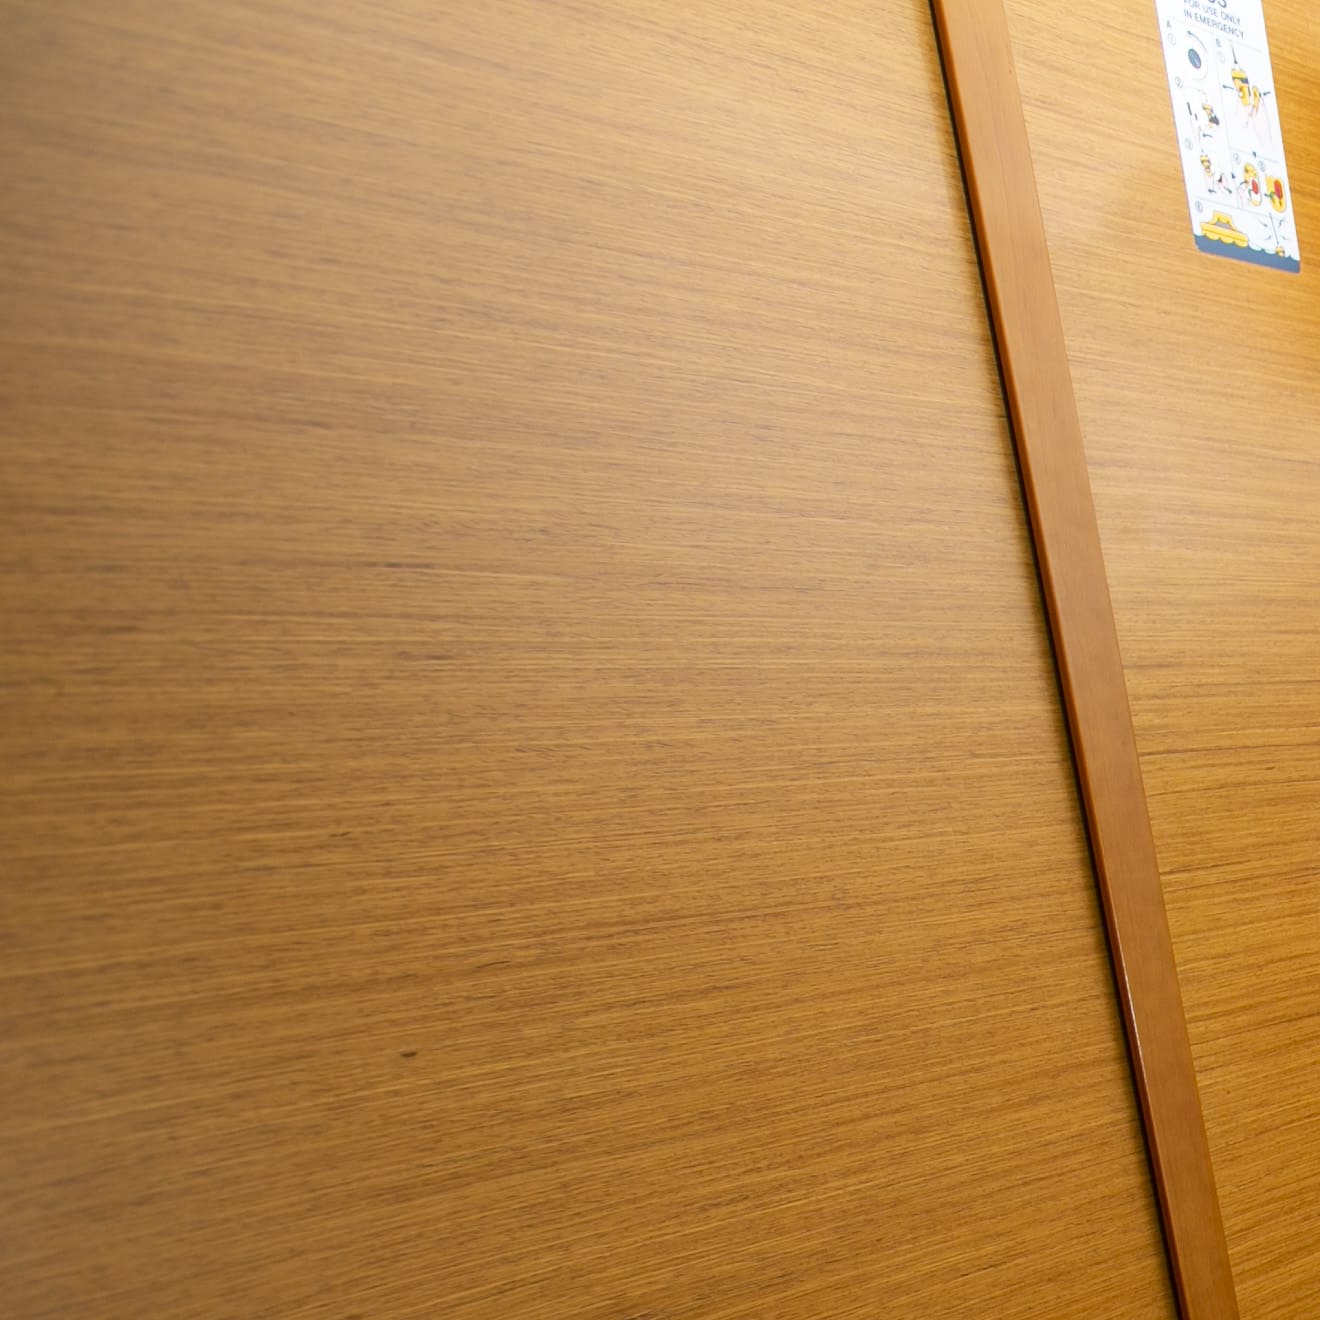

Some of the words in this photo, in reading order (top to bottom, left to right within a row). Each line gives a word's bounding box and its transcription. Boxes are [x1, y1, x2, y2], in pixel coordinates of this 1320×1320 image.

[1183, 8, 1192, 20] IN
[1194, 12, 1244, 40] EMERGENCY
[1220, 11, 1241, 26] ONLY
